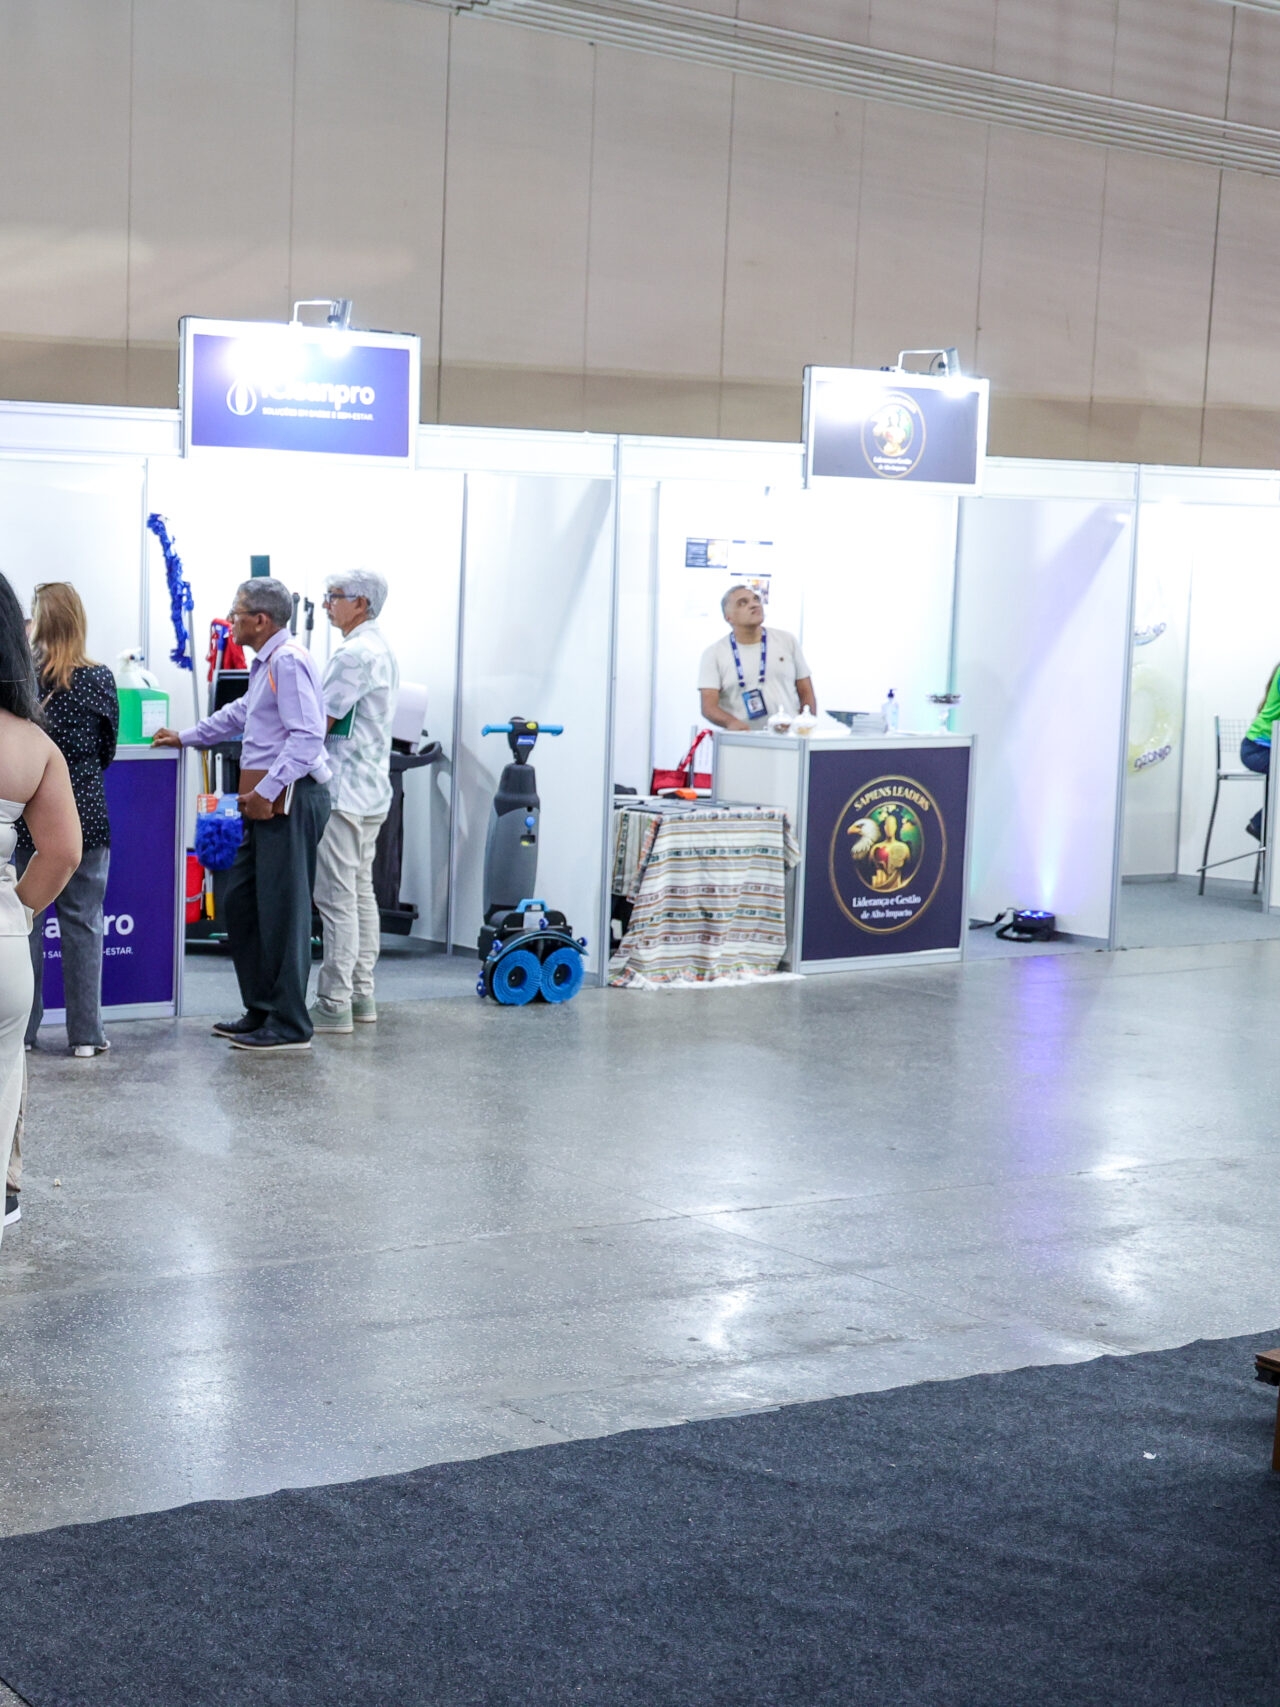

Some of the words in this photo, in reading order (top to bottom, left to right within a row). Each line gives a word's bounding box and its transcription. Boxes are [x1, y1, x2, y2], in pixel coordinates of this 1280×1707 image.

[853, 785, 892, 812] SAPIENS
[892, 785, 931, 812] LEADERS
[852, 896, 889, 908] Liderança
[895, 894, 922, 905] Gestão
[860, 910, 871, 920] de
[872, 909, 885, 919] Alto
[885, 908, 913, 920] Impacto
